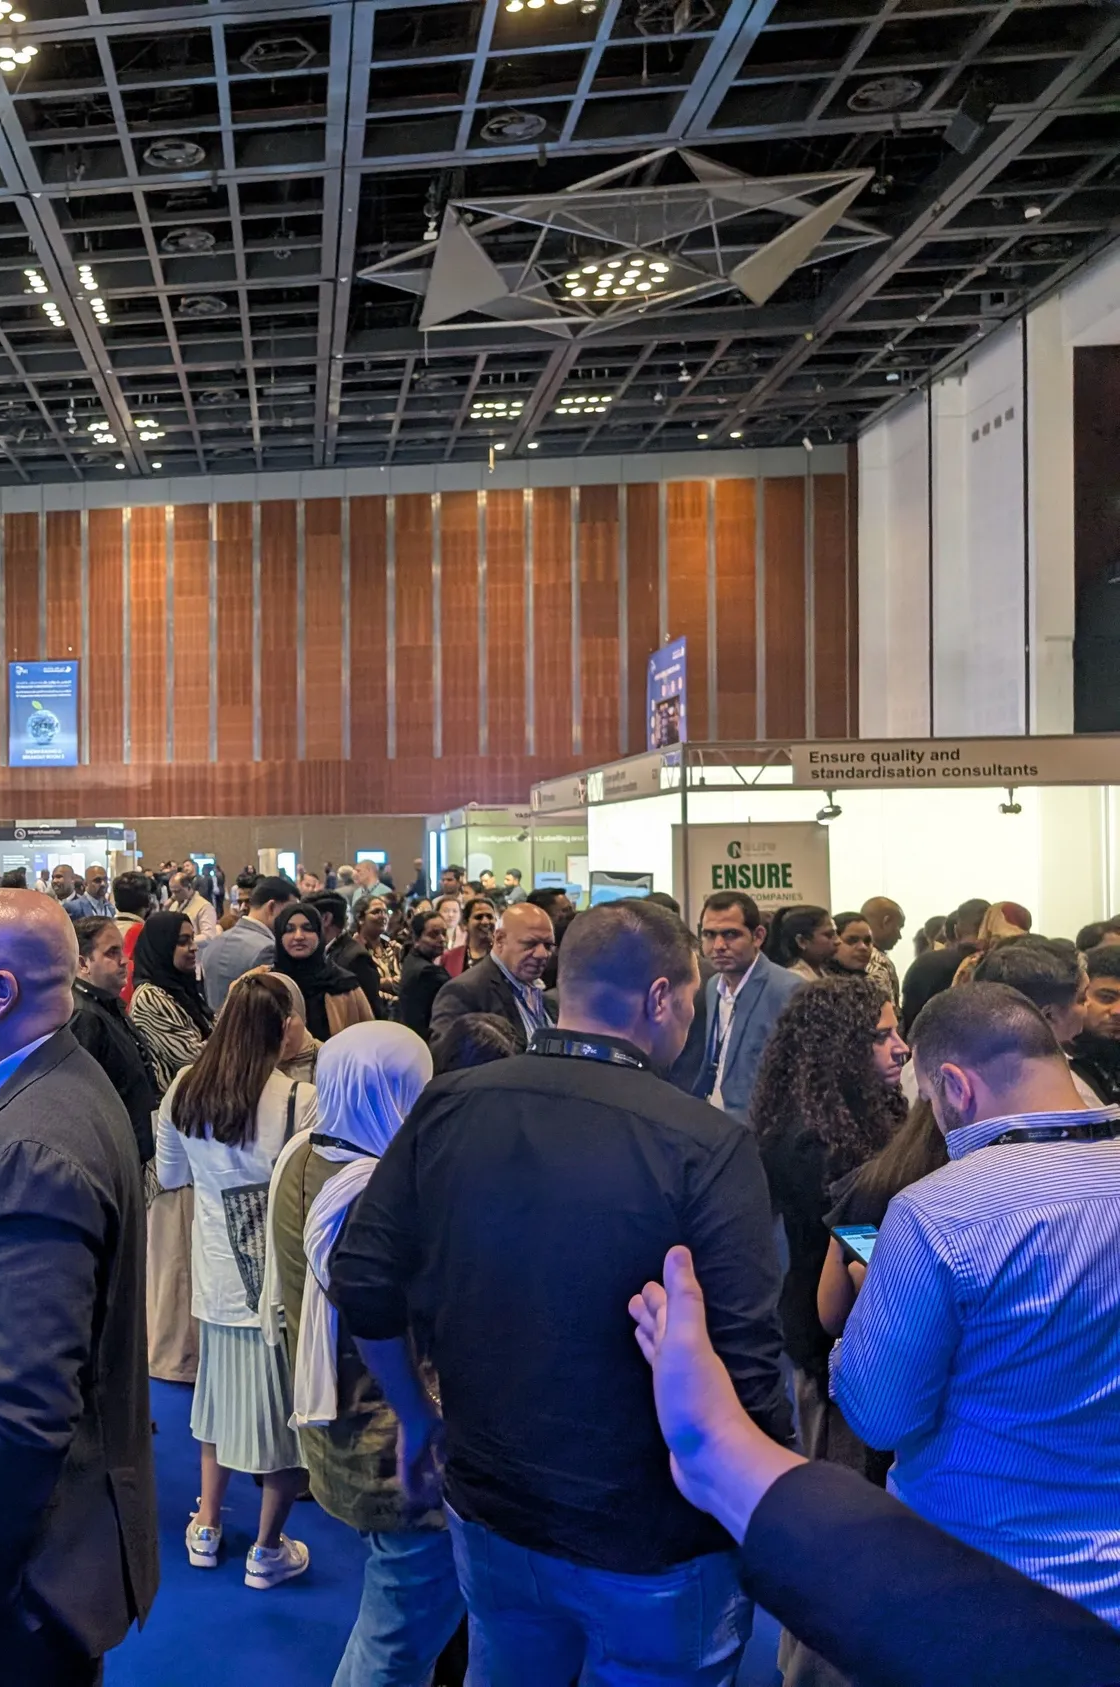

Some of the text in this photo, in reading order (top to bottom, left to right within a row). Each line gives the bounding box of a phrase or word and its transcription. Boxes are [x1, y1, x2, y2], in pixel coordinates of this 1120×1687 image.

[809, 748, 960, 766] Ensure quality and
[811, 763, 1038, 780] standardisation consultants
[711, 862, 793, 890] ENSURE
[750, 892, 803, 901] COMPANIES
